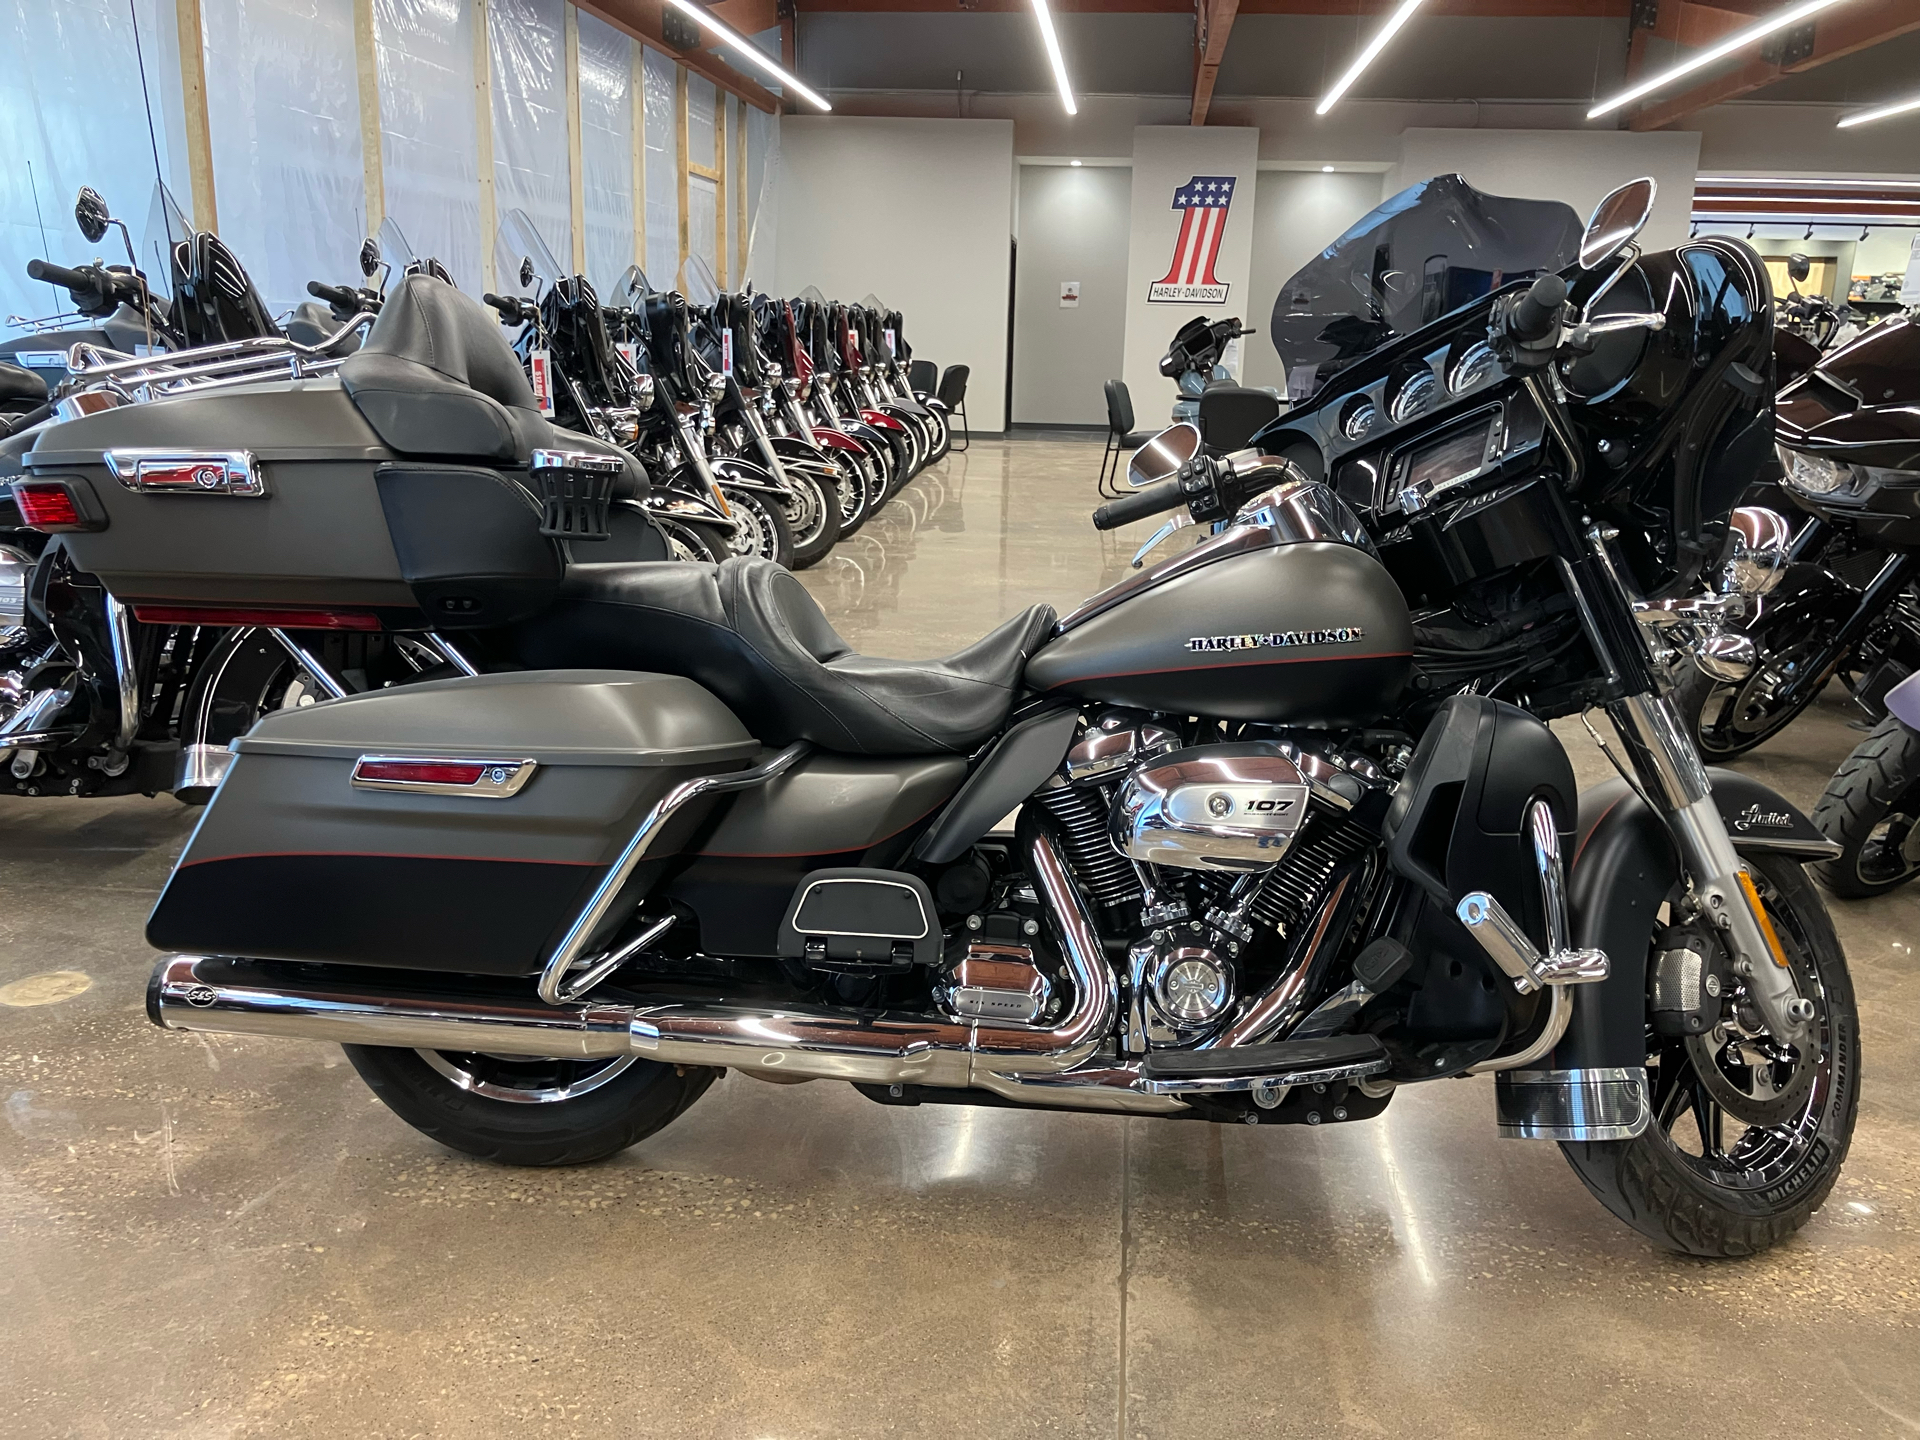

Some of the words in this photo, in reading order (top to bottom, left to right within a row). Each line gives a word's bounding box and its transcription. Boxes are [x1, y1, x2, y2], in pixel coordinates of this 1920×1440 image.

[1152, 286, 1224, 299] HARLEY-DAVIDSON
[1246, 799, 1296, 812] 107
[1734, 803, 1794, 830] Limited
[189, 990, 215, 1001] S&S
[1831, 1022, 1847, 1119] COMMANDER
[1765, 1143, 1827, 1203] MICHELIN
